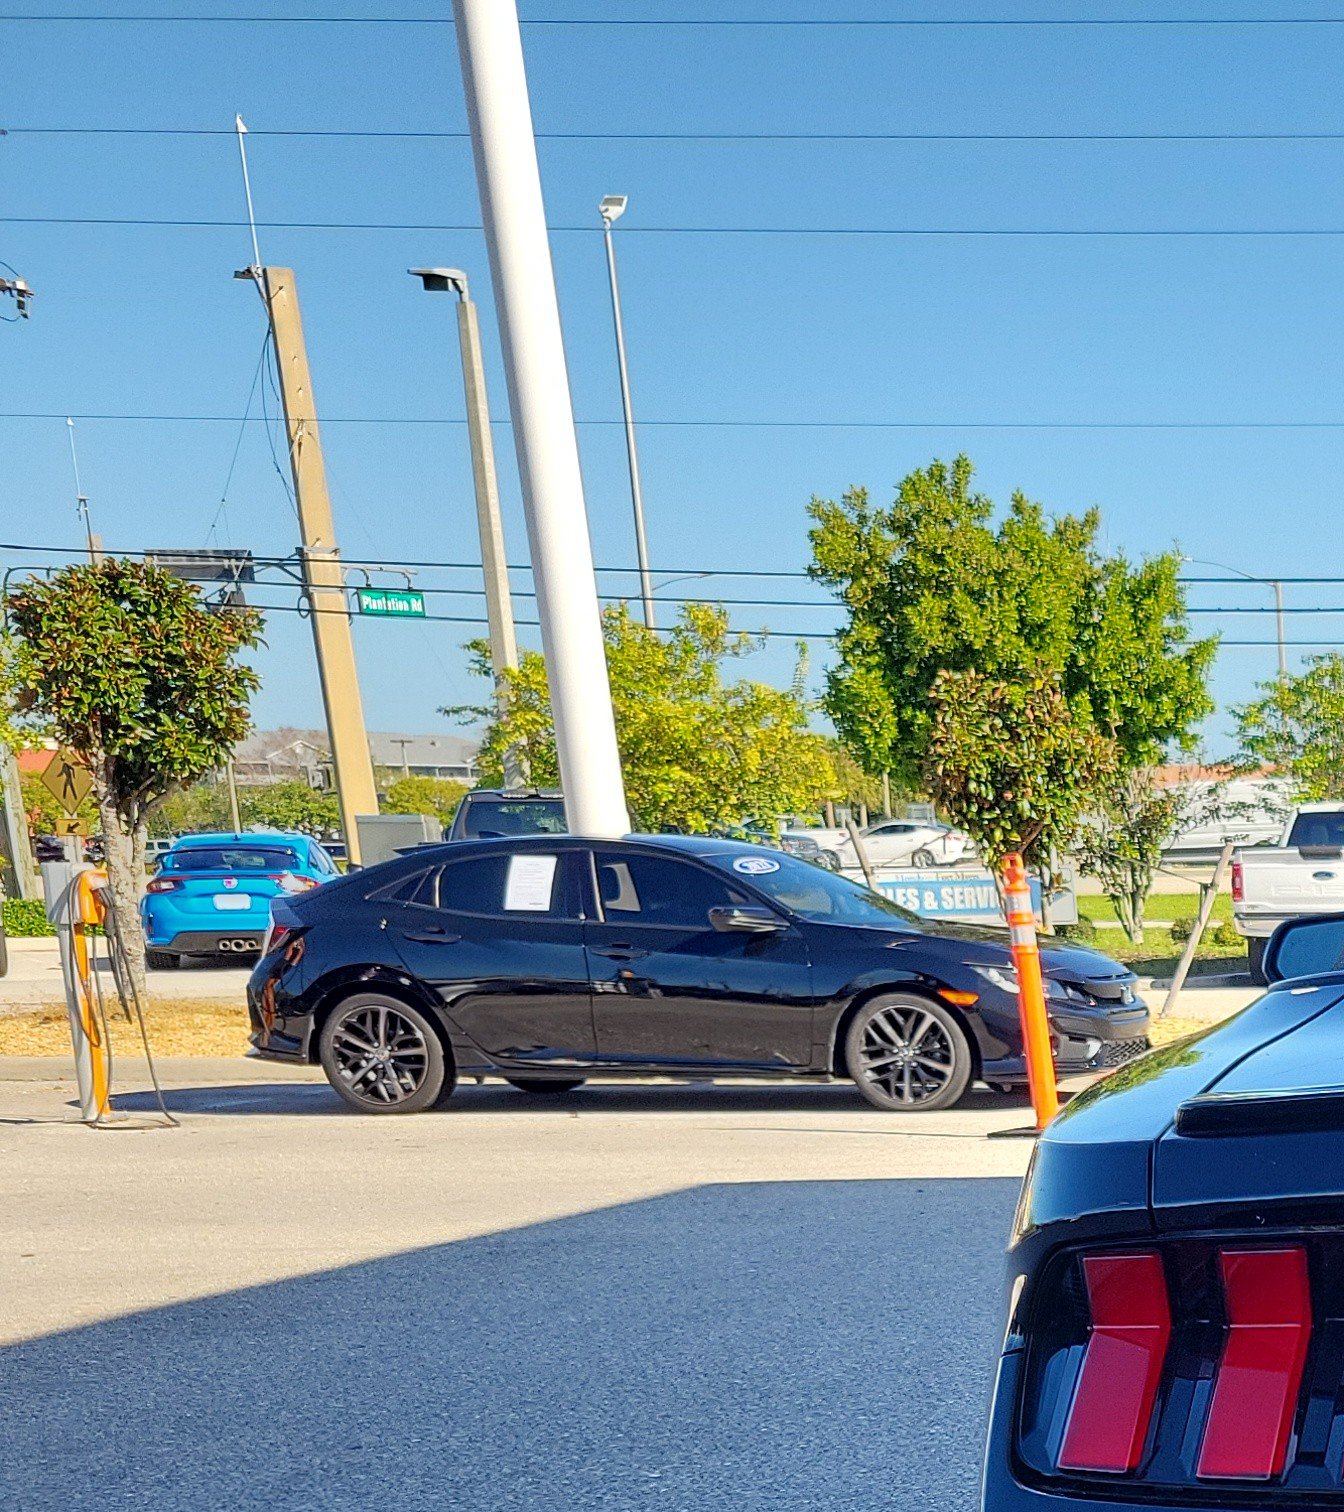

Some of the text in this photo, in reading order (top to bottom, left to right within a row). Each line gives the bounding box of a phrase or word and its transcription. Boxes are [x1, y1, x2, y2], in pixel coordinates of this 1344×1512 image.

[361, 594, 423, 612] Plantation Rd
[923, 890, 938, 910] &
[940, 886, 1003, 910] SERVI
